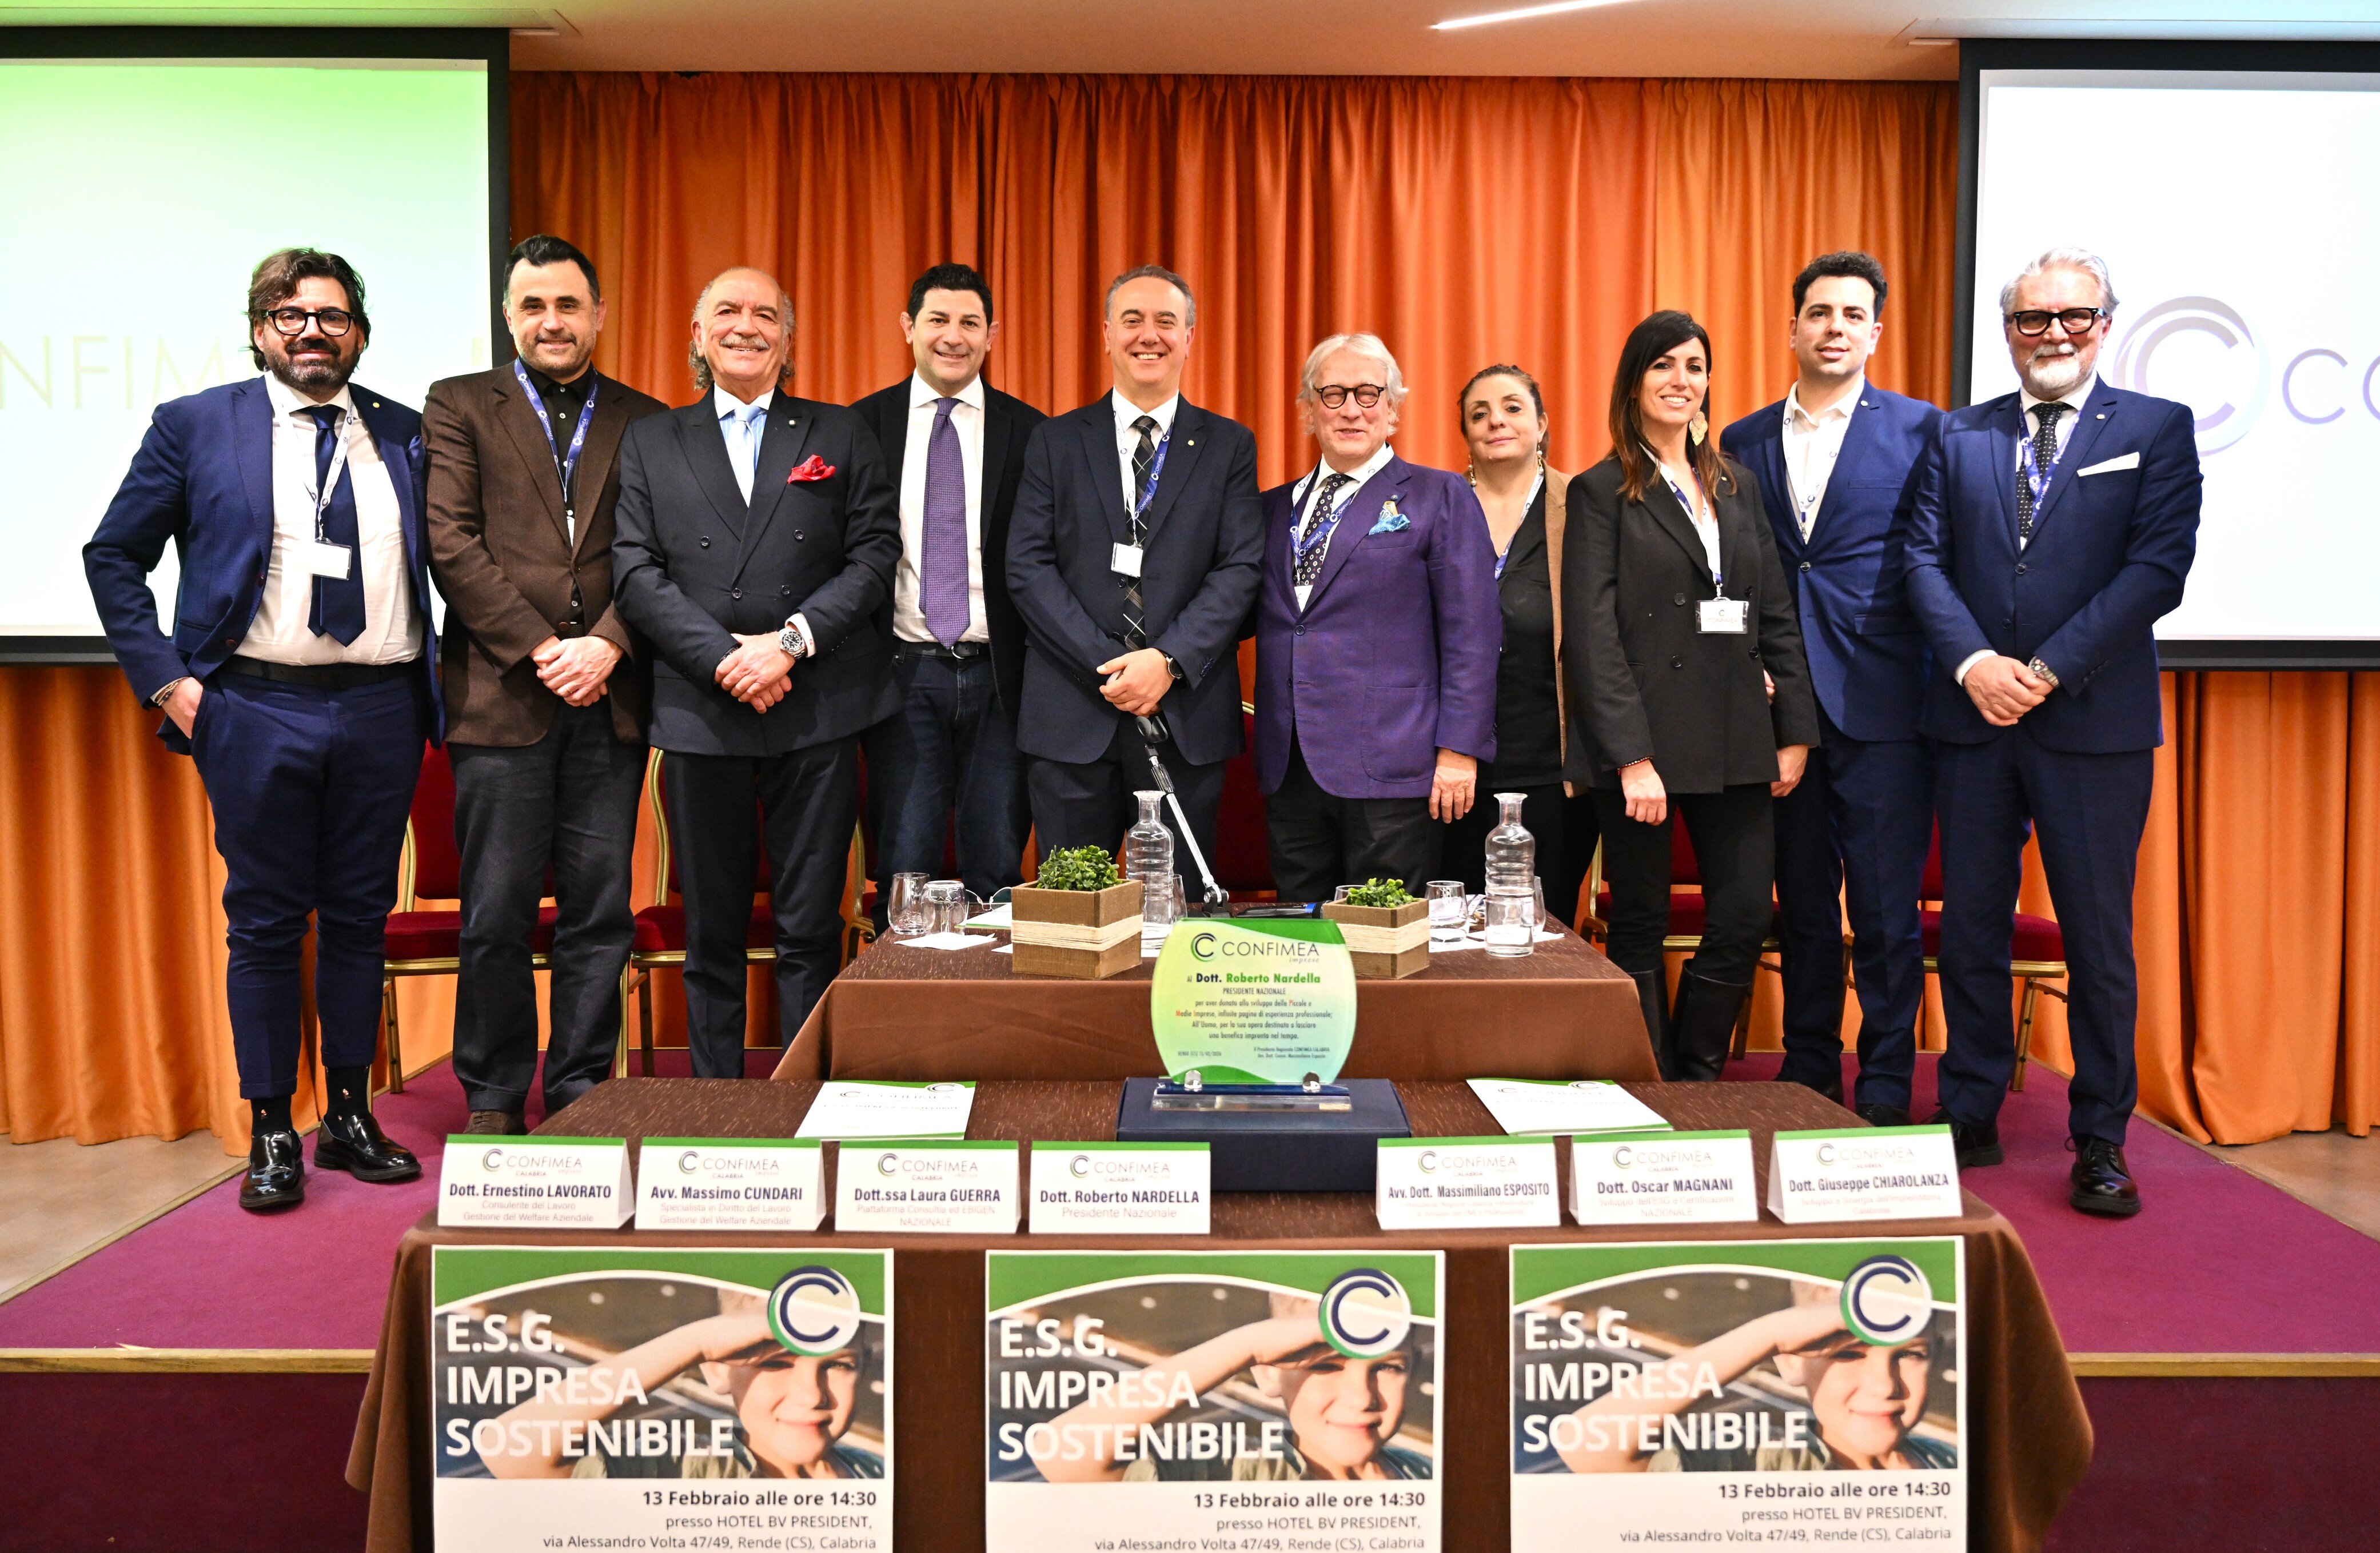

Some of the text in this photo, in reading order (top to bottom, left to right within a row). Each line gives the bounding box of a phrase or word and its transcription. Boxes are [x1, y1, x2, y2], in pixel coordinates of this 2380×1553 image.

[1155, 453, 1164, 474] CONFIMEA
[1138, 493, 1152, 513] CONFIMEA
[1304, 531, 1323, 551] CONFIMEA
[1222, 941, 1319, 956] CONFIMEA
[1196, 973, 1222, 983] Dott.
[1226, 972, 1270, 983] Roberto
[1274, 973, 1321, 983] Nardella
[1250, 999, 1273, 1007] sviluppo
[1193, 1010, 1216, 1019] Imprese,
[1238, 1010, 1257, 1019] pagine
[1265, 1010, 1294, 1019] esperienza
[1295, 1010, 1333, 1019] professionale;
[1245, 1032, 1269, 1040] impronta
[1281, 1032, 1299, 1040] tempo.
[507, 1155, 582, 1168] CONFIMEA
[703, 1158, 779, 1170] CONFIMEA
[1442, 1156, 1517, 1168] CONFIMEA
[1637, 1151, 1712, 1164] CONFIMEA
[902, 1160, 978, 1172] CONFIMEA
[1094, 1161, 1170, 1173] CONFIMEA
[1388, 1183, 1550, 1198] Avv. Dott. Massimiliano ESPOSITO
[1597, 1177, 1733, 1194] Dott. Oscar MAGNANI
[1789, 1173, 1949, 1193] Dott. Giuseppe CHIAROLANZA
[450, 1184, 612, 1198] Dott. Ernestino LAVORATO
[651, 1186, 802, 1200] Avv. Massimo CUNDARI
[854, 1188, 1000, 1201] Dott.ssa Laura GUERRA
[1040, 1189, 1199, 1203] Dott. Roberto NARDELLA
[482, 1200, 576, 1209] Consulente del Lavoro
[660, 1203, 791, 1213] Specialista in Diritto del Lavoro
[1062, 1207, 1177, 1217] Presidente Nazionale
[464, 1212, 594, 1222] Gestione del Welfare Aziendale
[660, 1215, 791, 1224] Gestione del Welfare Aziendale
[1641, 1208, 1693, 1217] NAZIONALE
[900, 1217, 952, 1226] NAZIONALE
[447, 1314, 565, 1352] E.S.G.
[1524, 1311, 1640, 1350] E.S.G.
[1000, 1319, 1117, 1358] E.S.G.
[448, 1367, 647, 1405] IMPRESA
[1525, 1362, 1722, 1400] IMPRESA
[1000, 1371, 1199, 1409] IMPRESA
[445, 1419, 734, 1457] SOSTENIBILE
[1523, 1412, 1808, 1453] SOSTENIBILE
[999, 1422, 1283, 1460] SOSTENIBILE
[1719, 1482, 1951, 1498] 13 Febbraio alle ore 14:30
[643, 1491, 876, 1506] 13 Febbraio alle ore 14:30
[1194, 1492, 1425, 1508] 13 Febbraio alle ore 14:30
[1742, 1506, 1947, 1522] presso HOTEL BV PRESIDENT,
[666, 1515, 872, 1531] presso HOTEL BV PRESIDENT,
[1217, 1516, 1420, 1533] presso HOTEL BV PRESIDENT,
[543, 1535, 876, 1551] via Alessandro Volta 47/49, Rende (CS), Calabria
[1620, 1527, 1951, 1544] via Alessandro Volta 47/49, Rende (CS), Calabria
[1095, 1537, 1424, 1552] via Alessandro Volta 47/49, Rende (CS), Calabria
